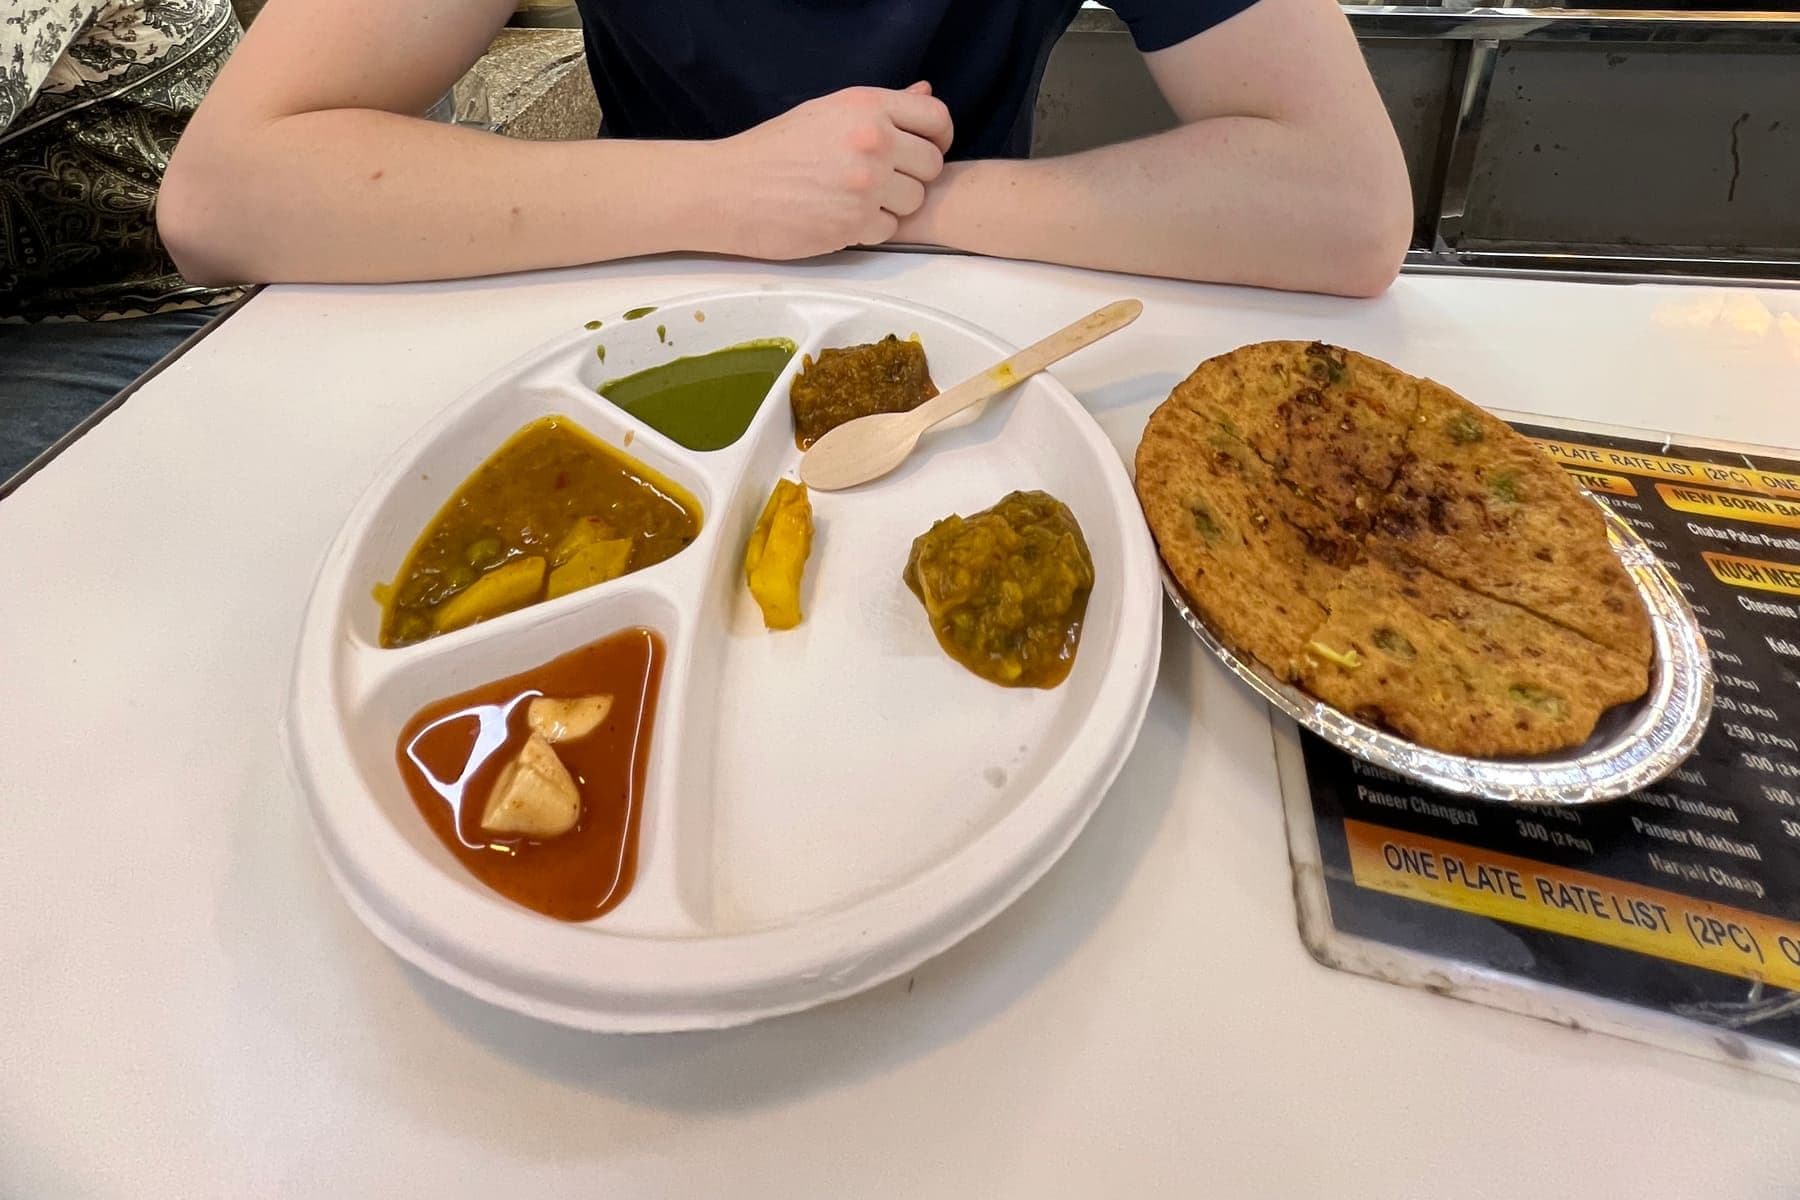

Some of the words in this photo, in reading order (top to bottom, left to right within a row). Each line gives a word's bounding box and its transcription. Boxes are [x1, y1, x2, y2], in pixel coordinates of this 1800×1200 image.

[1549, 444, 1603, 463] PLATE
[1609, 453, 1655, 471] RATE
[1657, 460, 1695, 477] LIST
[1703, 467, 1753, 488] (2PC)
[1761, 475, 1800, 490] ONE
[1572, 473, 1614, 490] TKE
[1672, 488, 1716, 506] NEW
[1717, 495, 1775, 515] BORN
[1711, 558, 1768, 584] KUCH
[1723, 722, 1755, 741] 250
[1741, 752, 1774, 772] 300
[1357, 784, 1409, 811] Paneer
[1410, 796, 1479, 826] Changezi
[1629, 791, 1671, 809] aneer
[1668, 794, 1740, 824] Tandoori
[1761, 784, 1796, 806] 300
[1516, 819, 1548, 842] 300
[1632, 816, 1690, 845] Paneer
[1687, 829, 1762, 861] Makhani
[1648, 852, 1710, 883] Haryali
[1709, 866, 1766, 899] Chaap
[1383, 844, 1439, 881] ONE
[1442, 857, 1526, 900] PLATE
[1535, 877, 1611, 920] RATE
[1612, 896, 1672, 934] LIST
[1685, 912, 1765, 965] (2PC)
